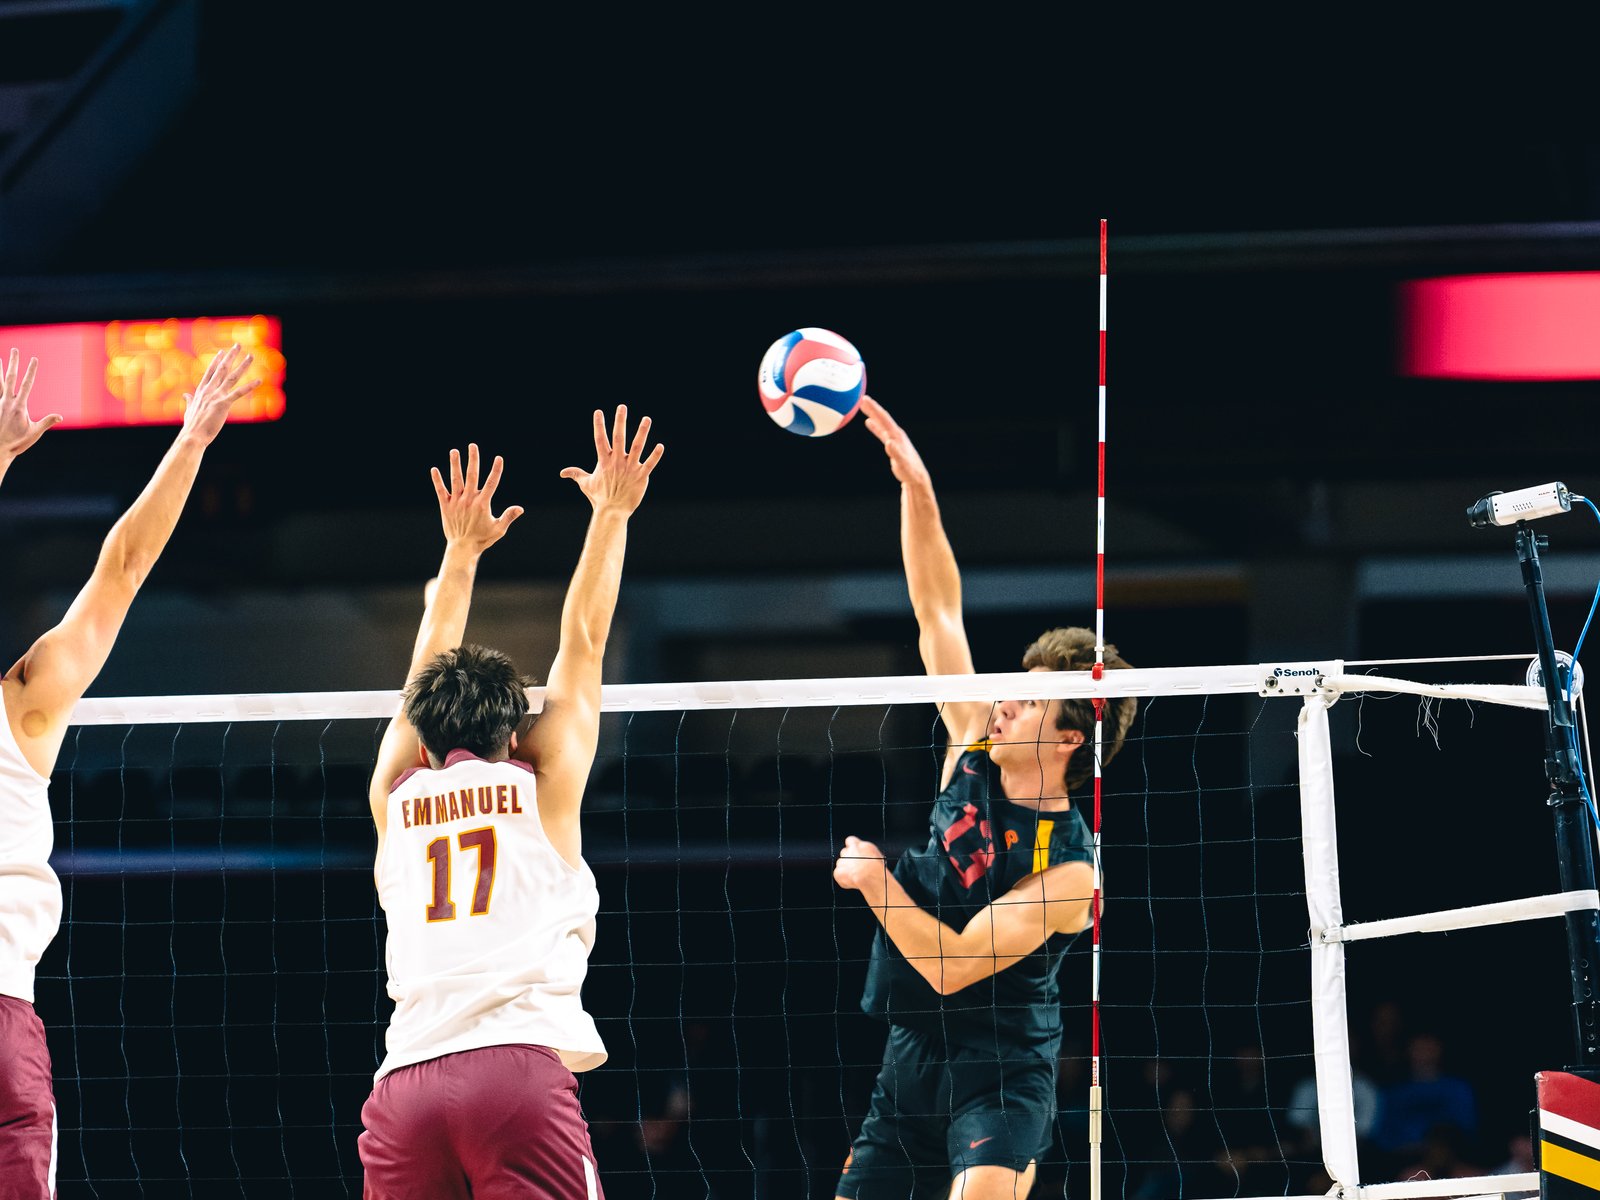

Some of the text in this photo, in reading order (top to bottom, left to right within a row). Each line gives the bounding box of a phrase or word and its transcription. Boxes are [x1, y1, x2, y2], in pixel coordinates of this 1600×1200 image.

[1284, 668, 1320, 677] Senoh
[402, 784, 523, 829] EMMANUEL
[426, 825, 497, 923] 17
